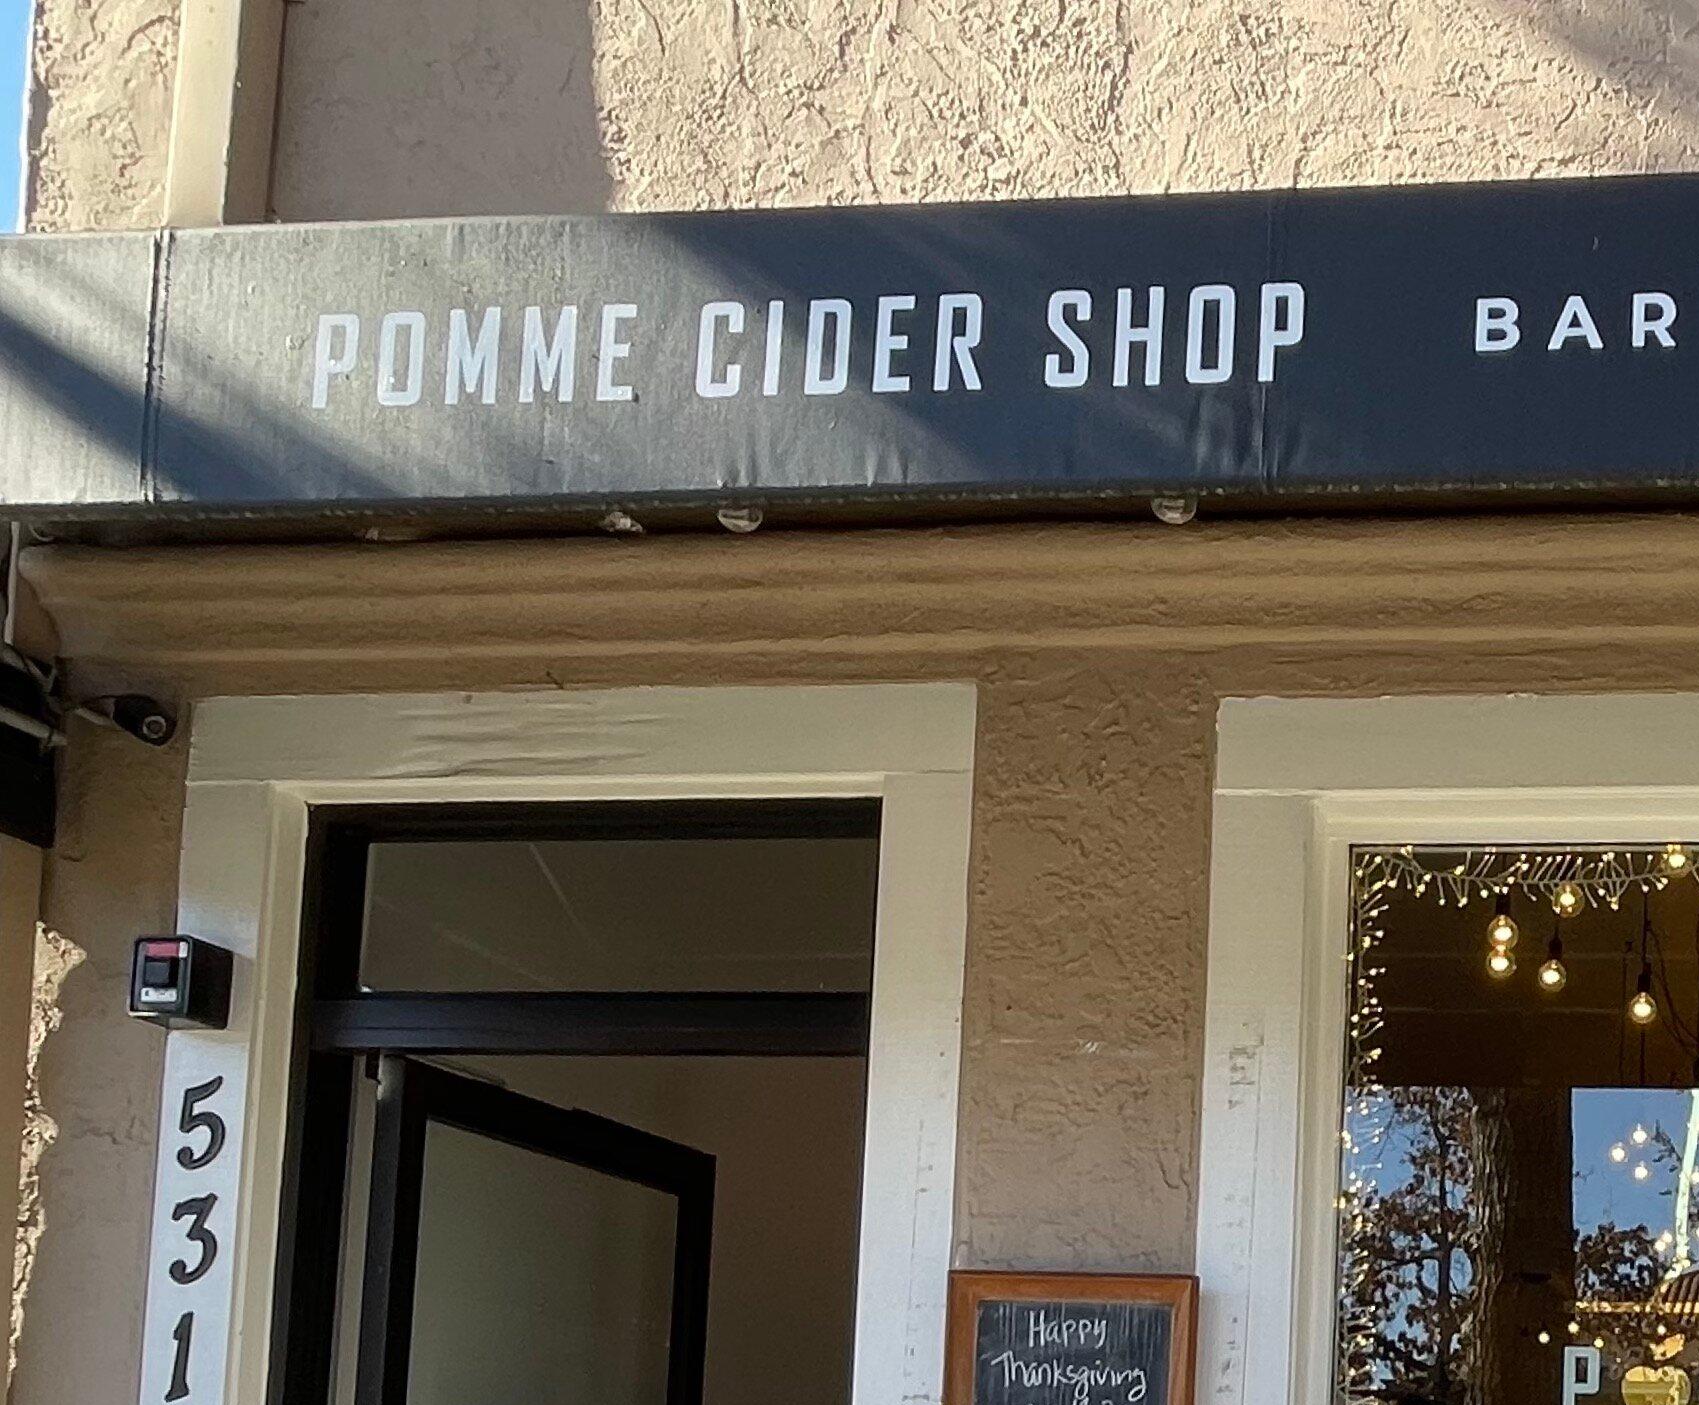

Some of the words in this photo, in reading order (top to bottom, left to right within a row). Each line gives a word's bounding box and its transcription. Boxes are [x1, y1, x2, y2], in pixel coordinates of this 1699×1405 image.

[311, 303, 638, 409] POMME
[695, 293, 984, 398] CIDER
[1045, 282, 1305, 389] SHOP
[1473, 290, 1679, 353] BAR
[1028, 1309, 1107, 1349] Happy
[991, 1351, 1148, 1402] Thanksgiving
